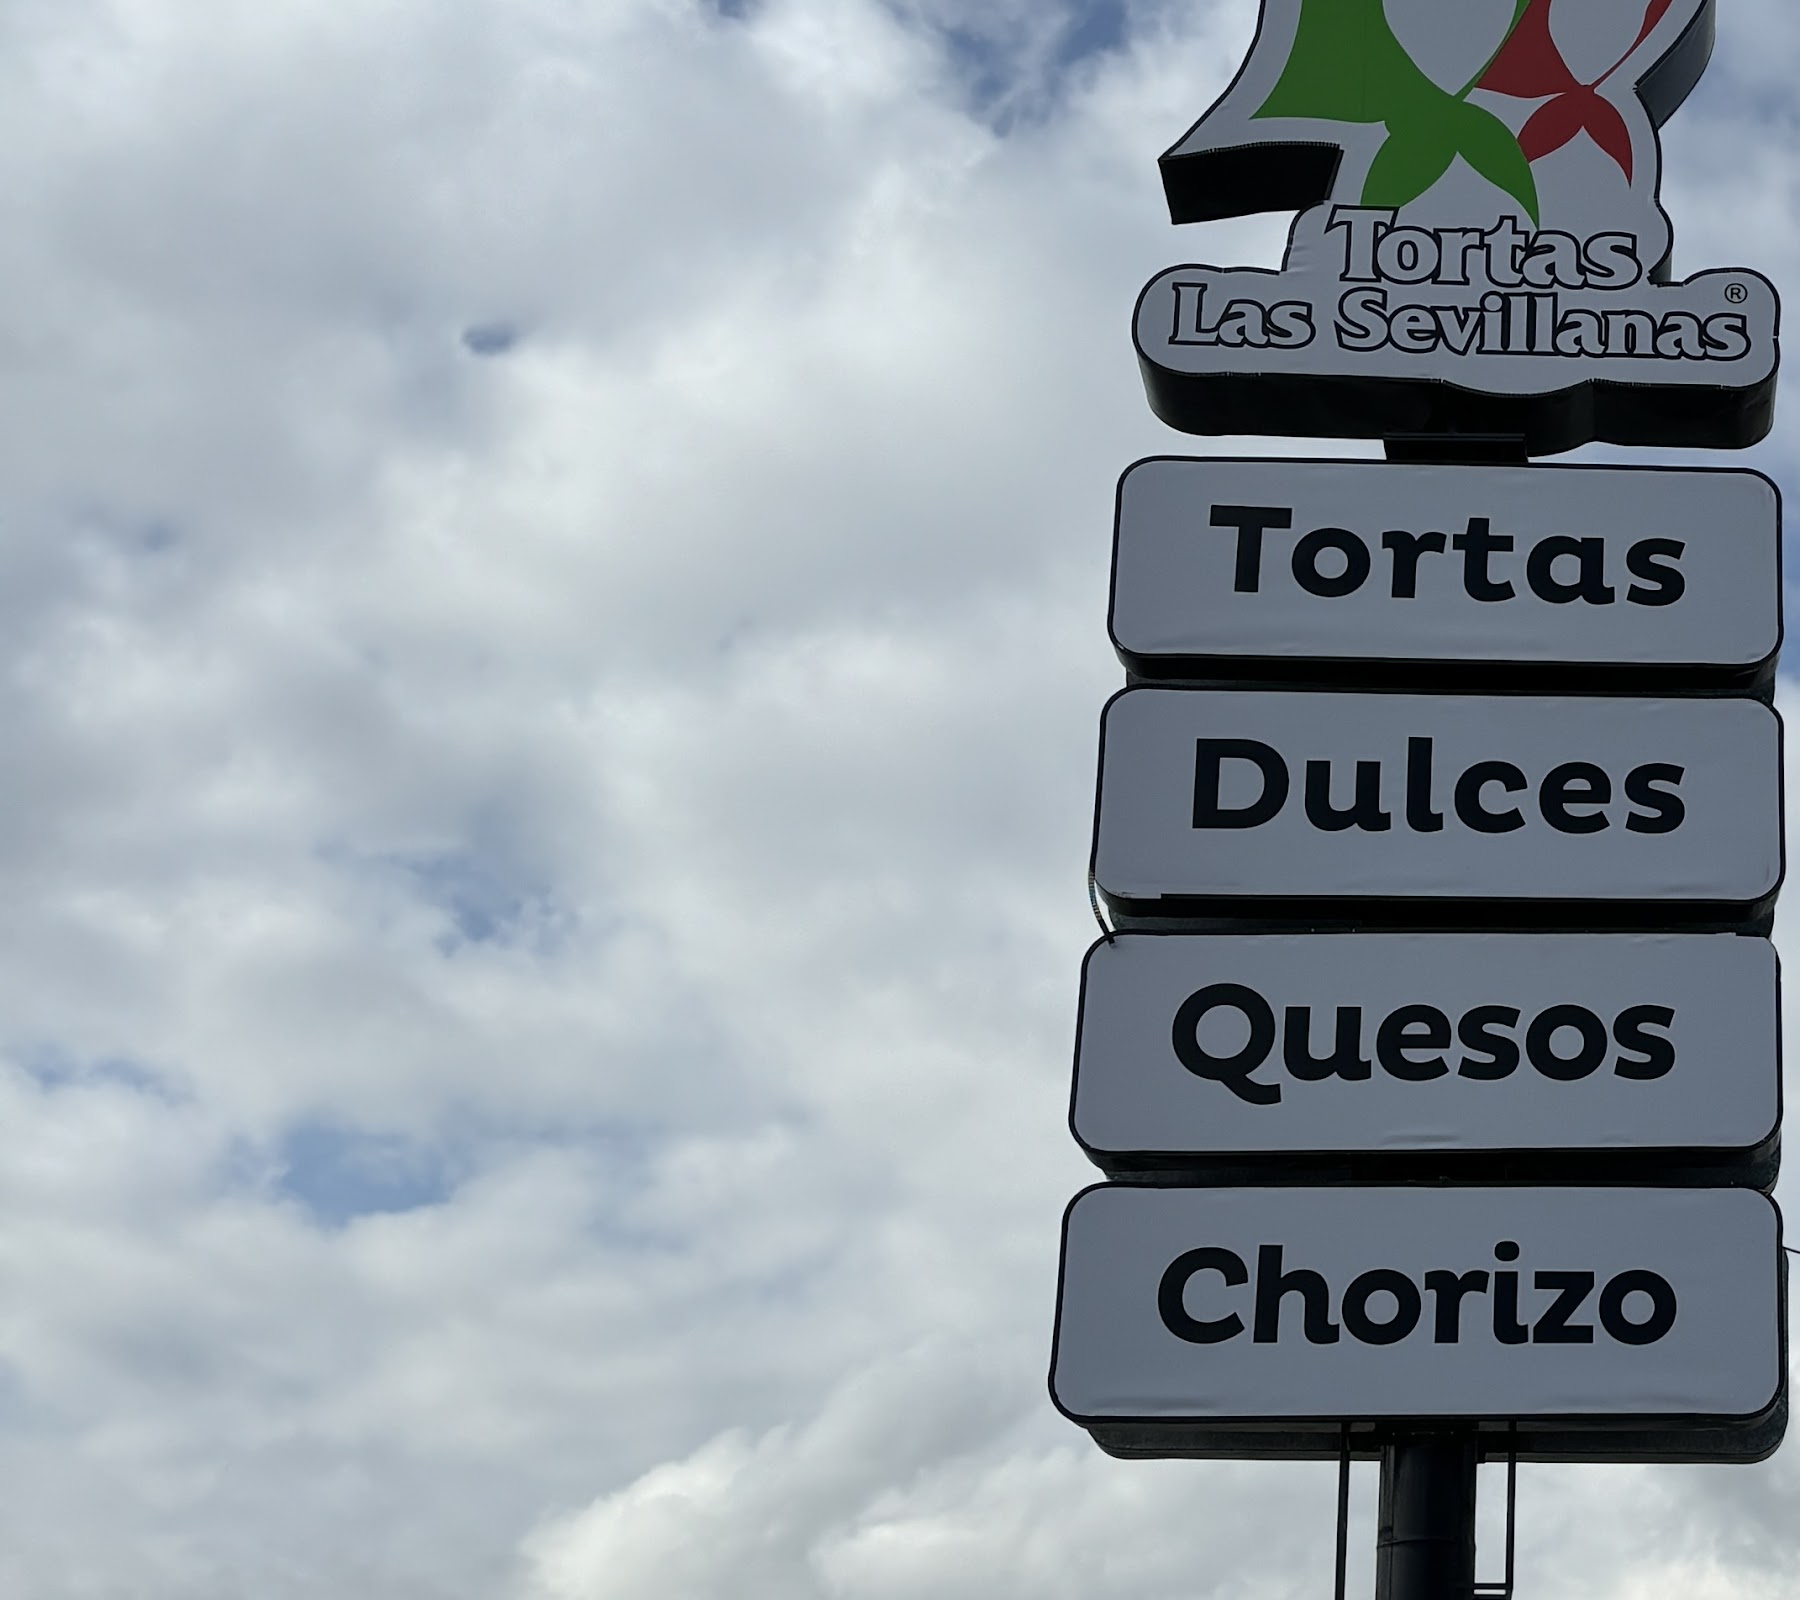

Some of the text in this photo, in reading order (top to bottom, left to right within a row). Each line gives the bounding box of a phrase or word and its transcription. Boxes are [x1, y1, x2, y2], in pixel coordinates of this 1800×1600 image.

[1325, 205, 1650, 289] Tortas
[1168, 283, 1316, 351] Las
[1334, 286, 1752, 362] Sevillanas
[1209, 505, 1687, 608] Tortas
[1191, 736, 1687, 835] Dulces
[1172, 983, 1677, 1106] Quesos
[1157, 1240, 1678, 1346] Chorizo
